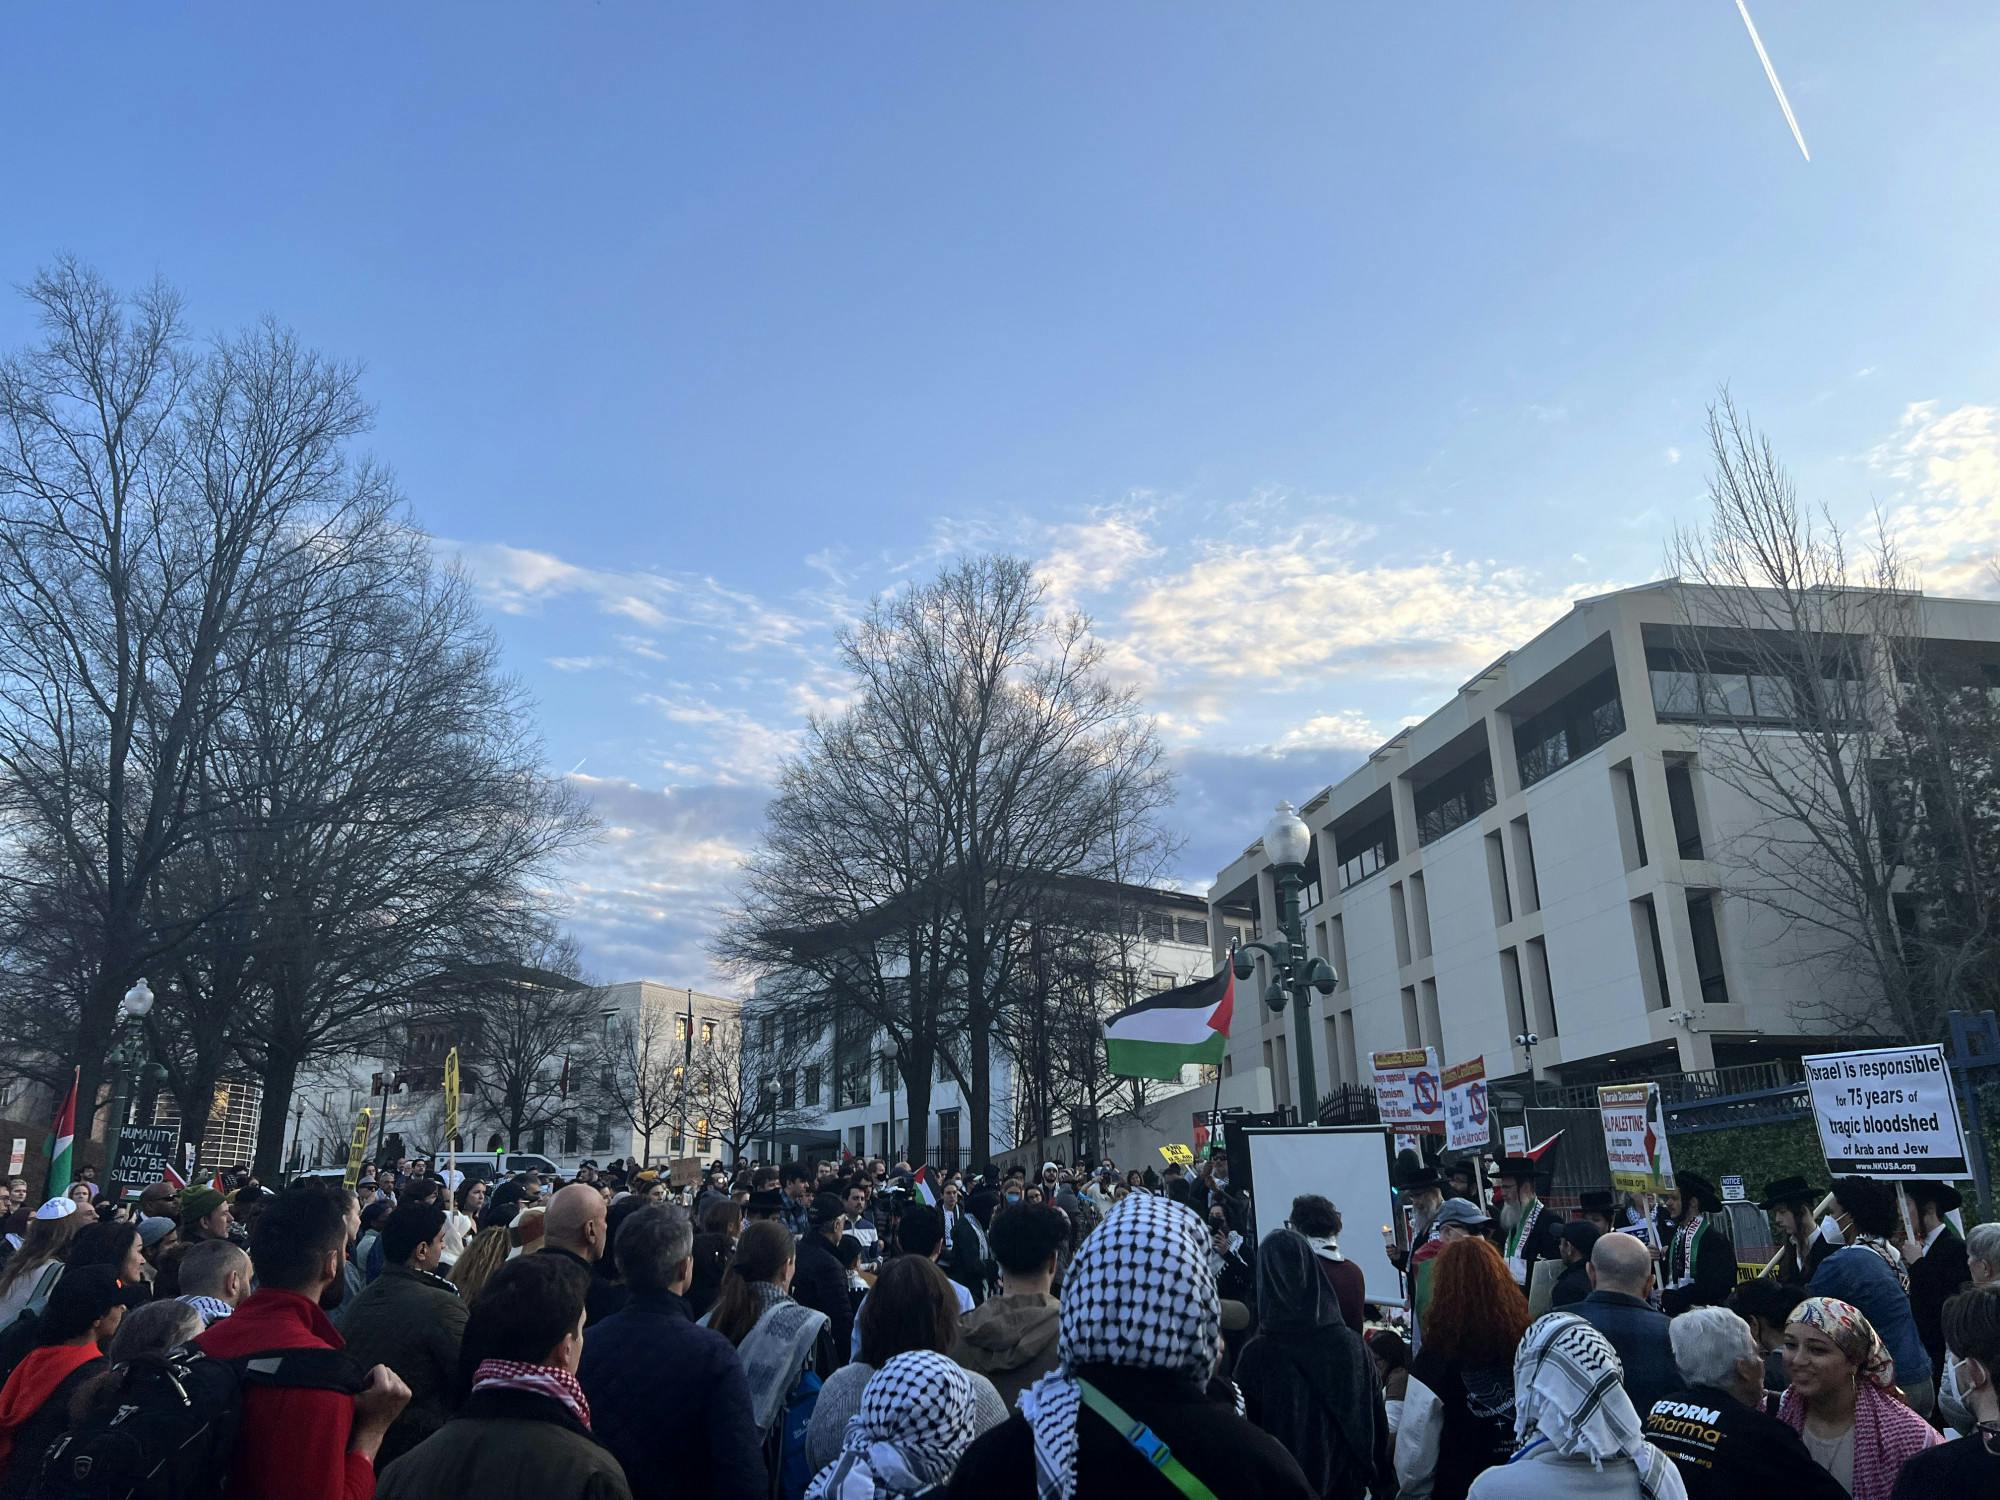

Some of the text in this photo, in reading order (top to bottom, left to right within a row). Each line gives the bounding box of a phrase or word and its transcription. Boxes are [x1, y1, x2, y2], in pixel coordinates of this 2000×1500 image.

[1807, 1054, 1940, 1081] Israel is responsible
[1378, 1088, 1404, 1099] Zionism
[1836, 1088, 1918, 1109] for 75 years of
[1397, 1106, 1412, 1117] Israel
[1611, 1115, 1644, 1132] PALESTINE
[1829, 1113, 1939, 1138] tragic bloodshed
[120, 1126, 174, 1142] HUMANITY
[132, 1142, 162, 1156] WILL
[1843, 1143, 1928, 1155] of Arab and Jew
[120, 1155, 166, 1170] NOT BE
[1855, 1162, 1916, 1172] www.NKUSA.org
[111, 1169, 163, 1184] SILENCED
[1722, 1177, 1741, 1185] NOTICE
[1738, 1267, 1755, 1280] FULL
